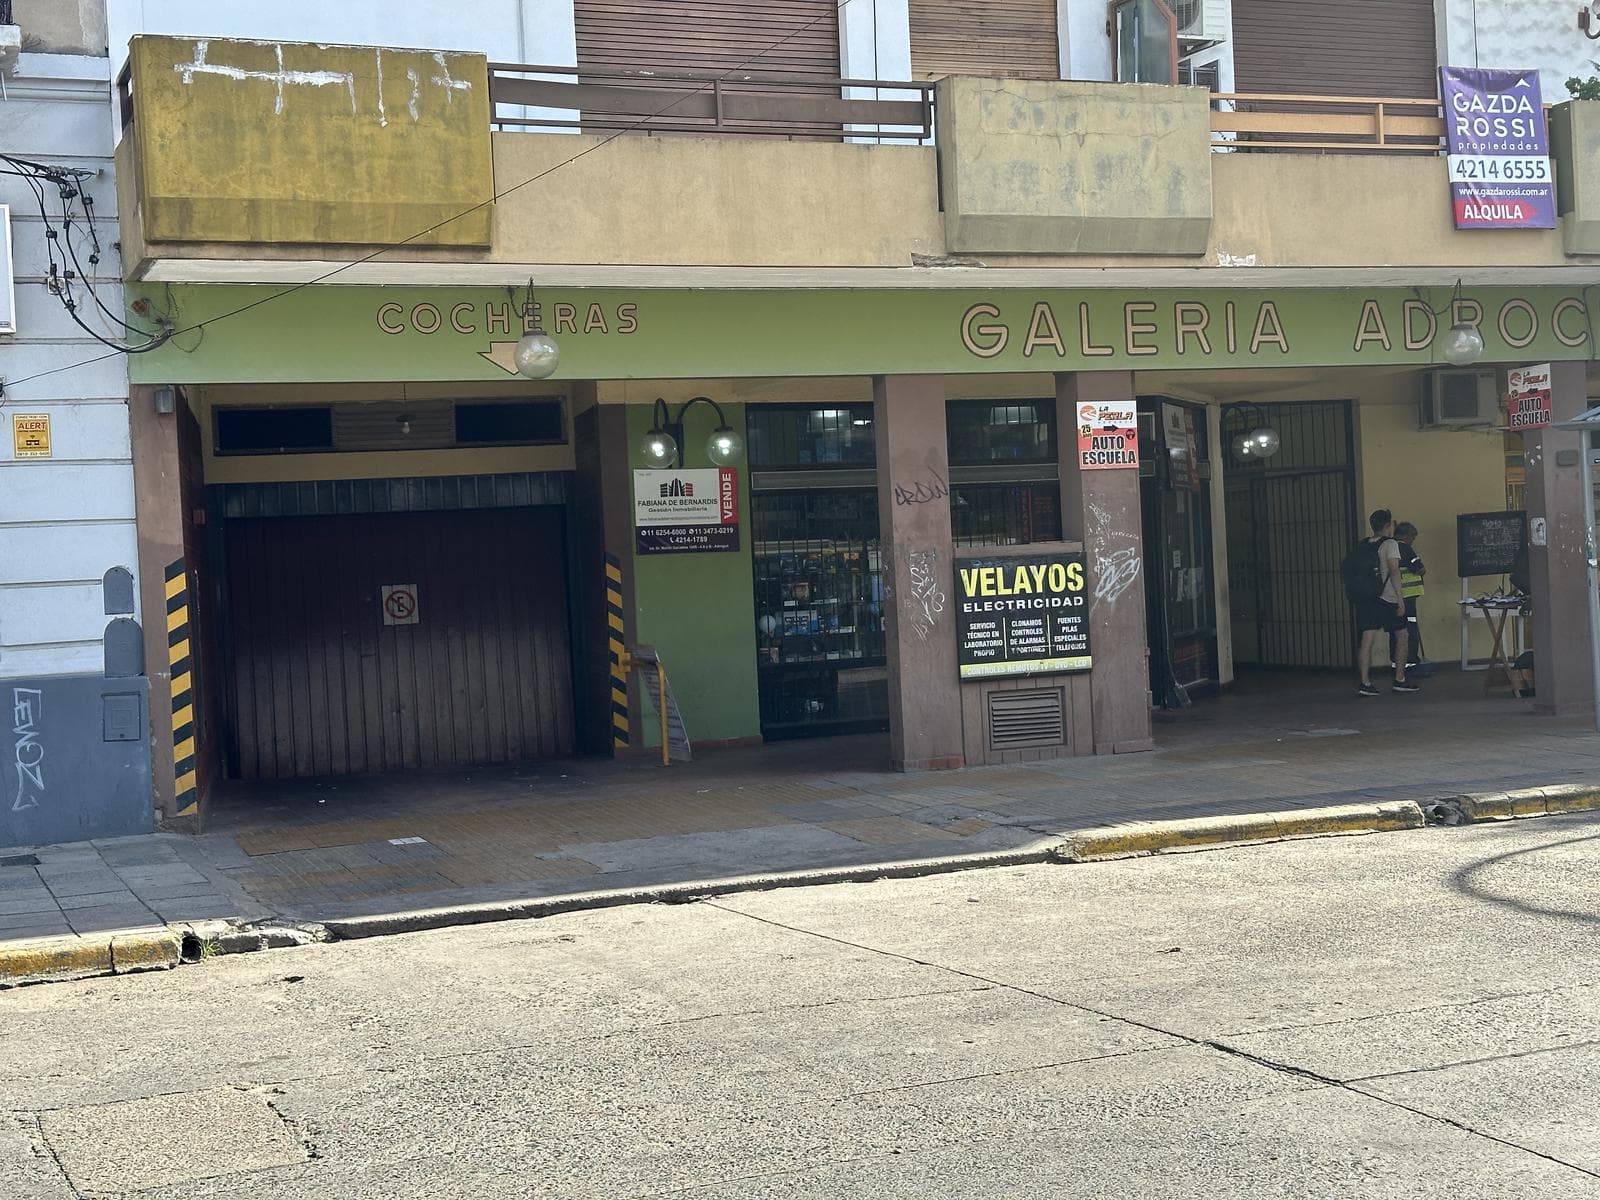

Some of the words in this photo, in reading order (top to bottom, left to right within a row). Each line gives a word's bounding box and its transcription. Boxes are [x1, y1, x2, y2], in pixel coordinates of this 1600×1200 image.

[1453, 92, 1535, 114] GAZDA
[1456, 116, 1536, 138] ROSSI
[1458, 140, 1539, 151] propiedades
[1456, 159, 1499, 179] 4214
[1503, 160, 1546, 179] 6555
[1458, 187, 1548, 198] www.gazdarossi.com.ar
[1464, 204, 1524, 221] ALQUILA
[376, 302, 639, 335] COCHERAS
[960, 301, 1289, 358] GALERIA
[1519, 397, 1542, 412] AUTO
[1098, 411, 1133, 420] PERLA
[1511, 410, 1550, 427] ESCUELA
[18, 421, 46, 429] ALERT
[1081, 424, 1091, 433] 25
[1092, 436, 1125, 450] AUTO
[1082, 451, 1136, 464] ESCUELA
[722, 473, 733, 519] VENDE
[637, 499, 667, 507] FABIANA
[960, 562, 1085, 598] VELAYOS
[963, 596, 1084, 613] ELECTRICIDAD
[969, 621, 996, 630] SERVICIO
[1011, 619, 1042, 627] CLONAMOS
[1057, 616, 1082, 625] FUENTES
[991, 630, 1000, 638] EN
[1011, 628, 1044, 636] CONTROLES
[1061, 625, 1078, 633] PILAS
[964, 639, 1003, 648] LABORATORIO
[1018, 637, 1046, 645] ALARMAS
[1054, 634, 1087, 642] ESPECIALES
[973, 649, 995, 657] PROPIO
[967, 665, 1005, 676] CONTROLES
[1007, 663, 1039, 672] REMOTOS
[1039, 662, 1048, 670] TV
